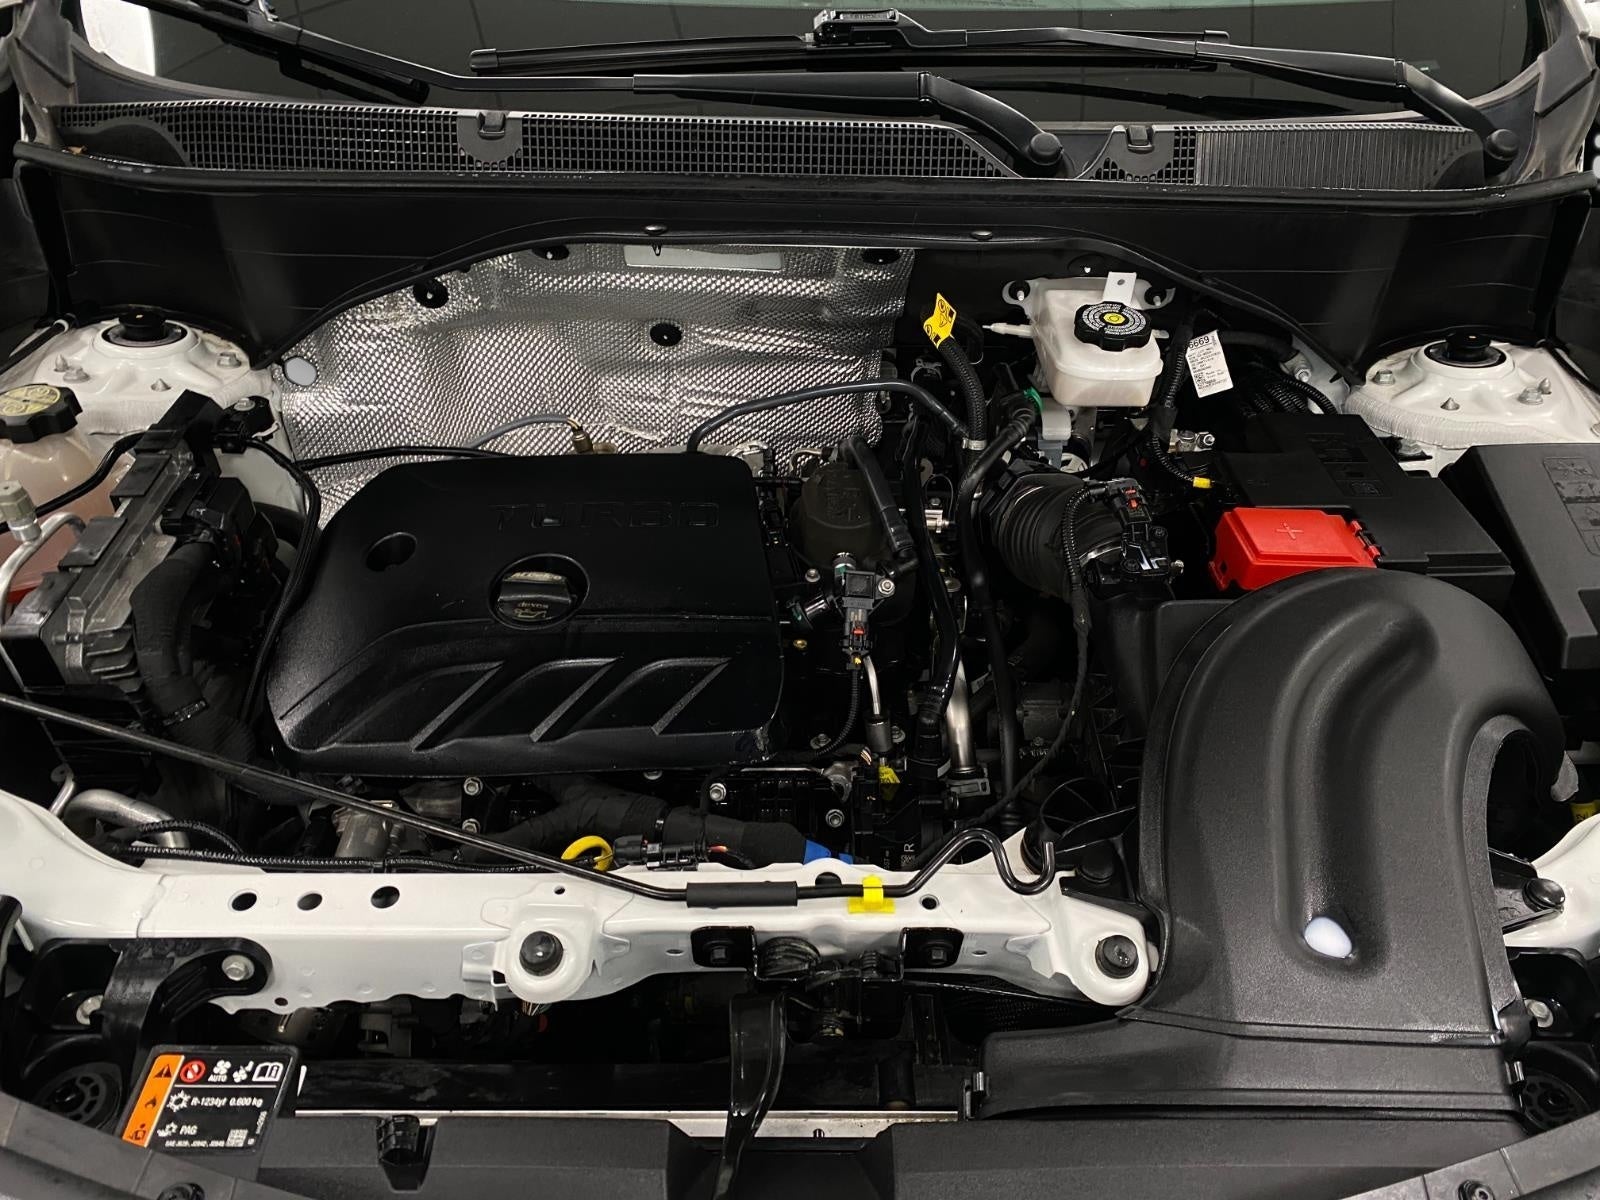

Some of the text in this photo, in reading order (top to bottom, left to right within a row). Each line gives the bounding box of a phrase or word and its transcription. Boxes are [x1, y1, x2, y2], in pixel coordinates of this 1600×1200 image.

[488, 501, 721, 531] TURBO
[207, 1074, 228, 1082] AUTO
[190, 1097, 227, 1107] R-1234yf
[252, 1097, 263, 1108] kg
[179, 1125, 198, 1136] PAG
